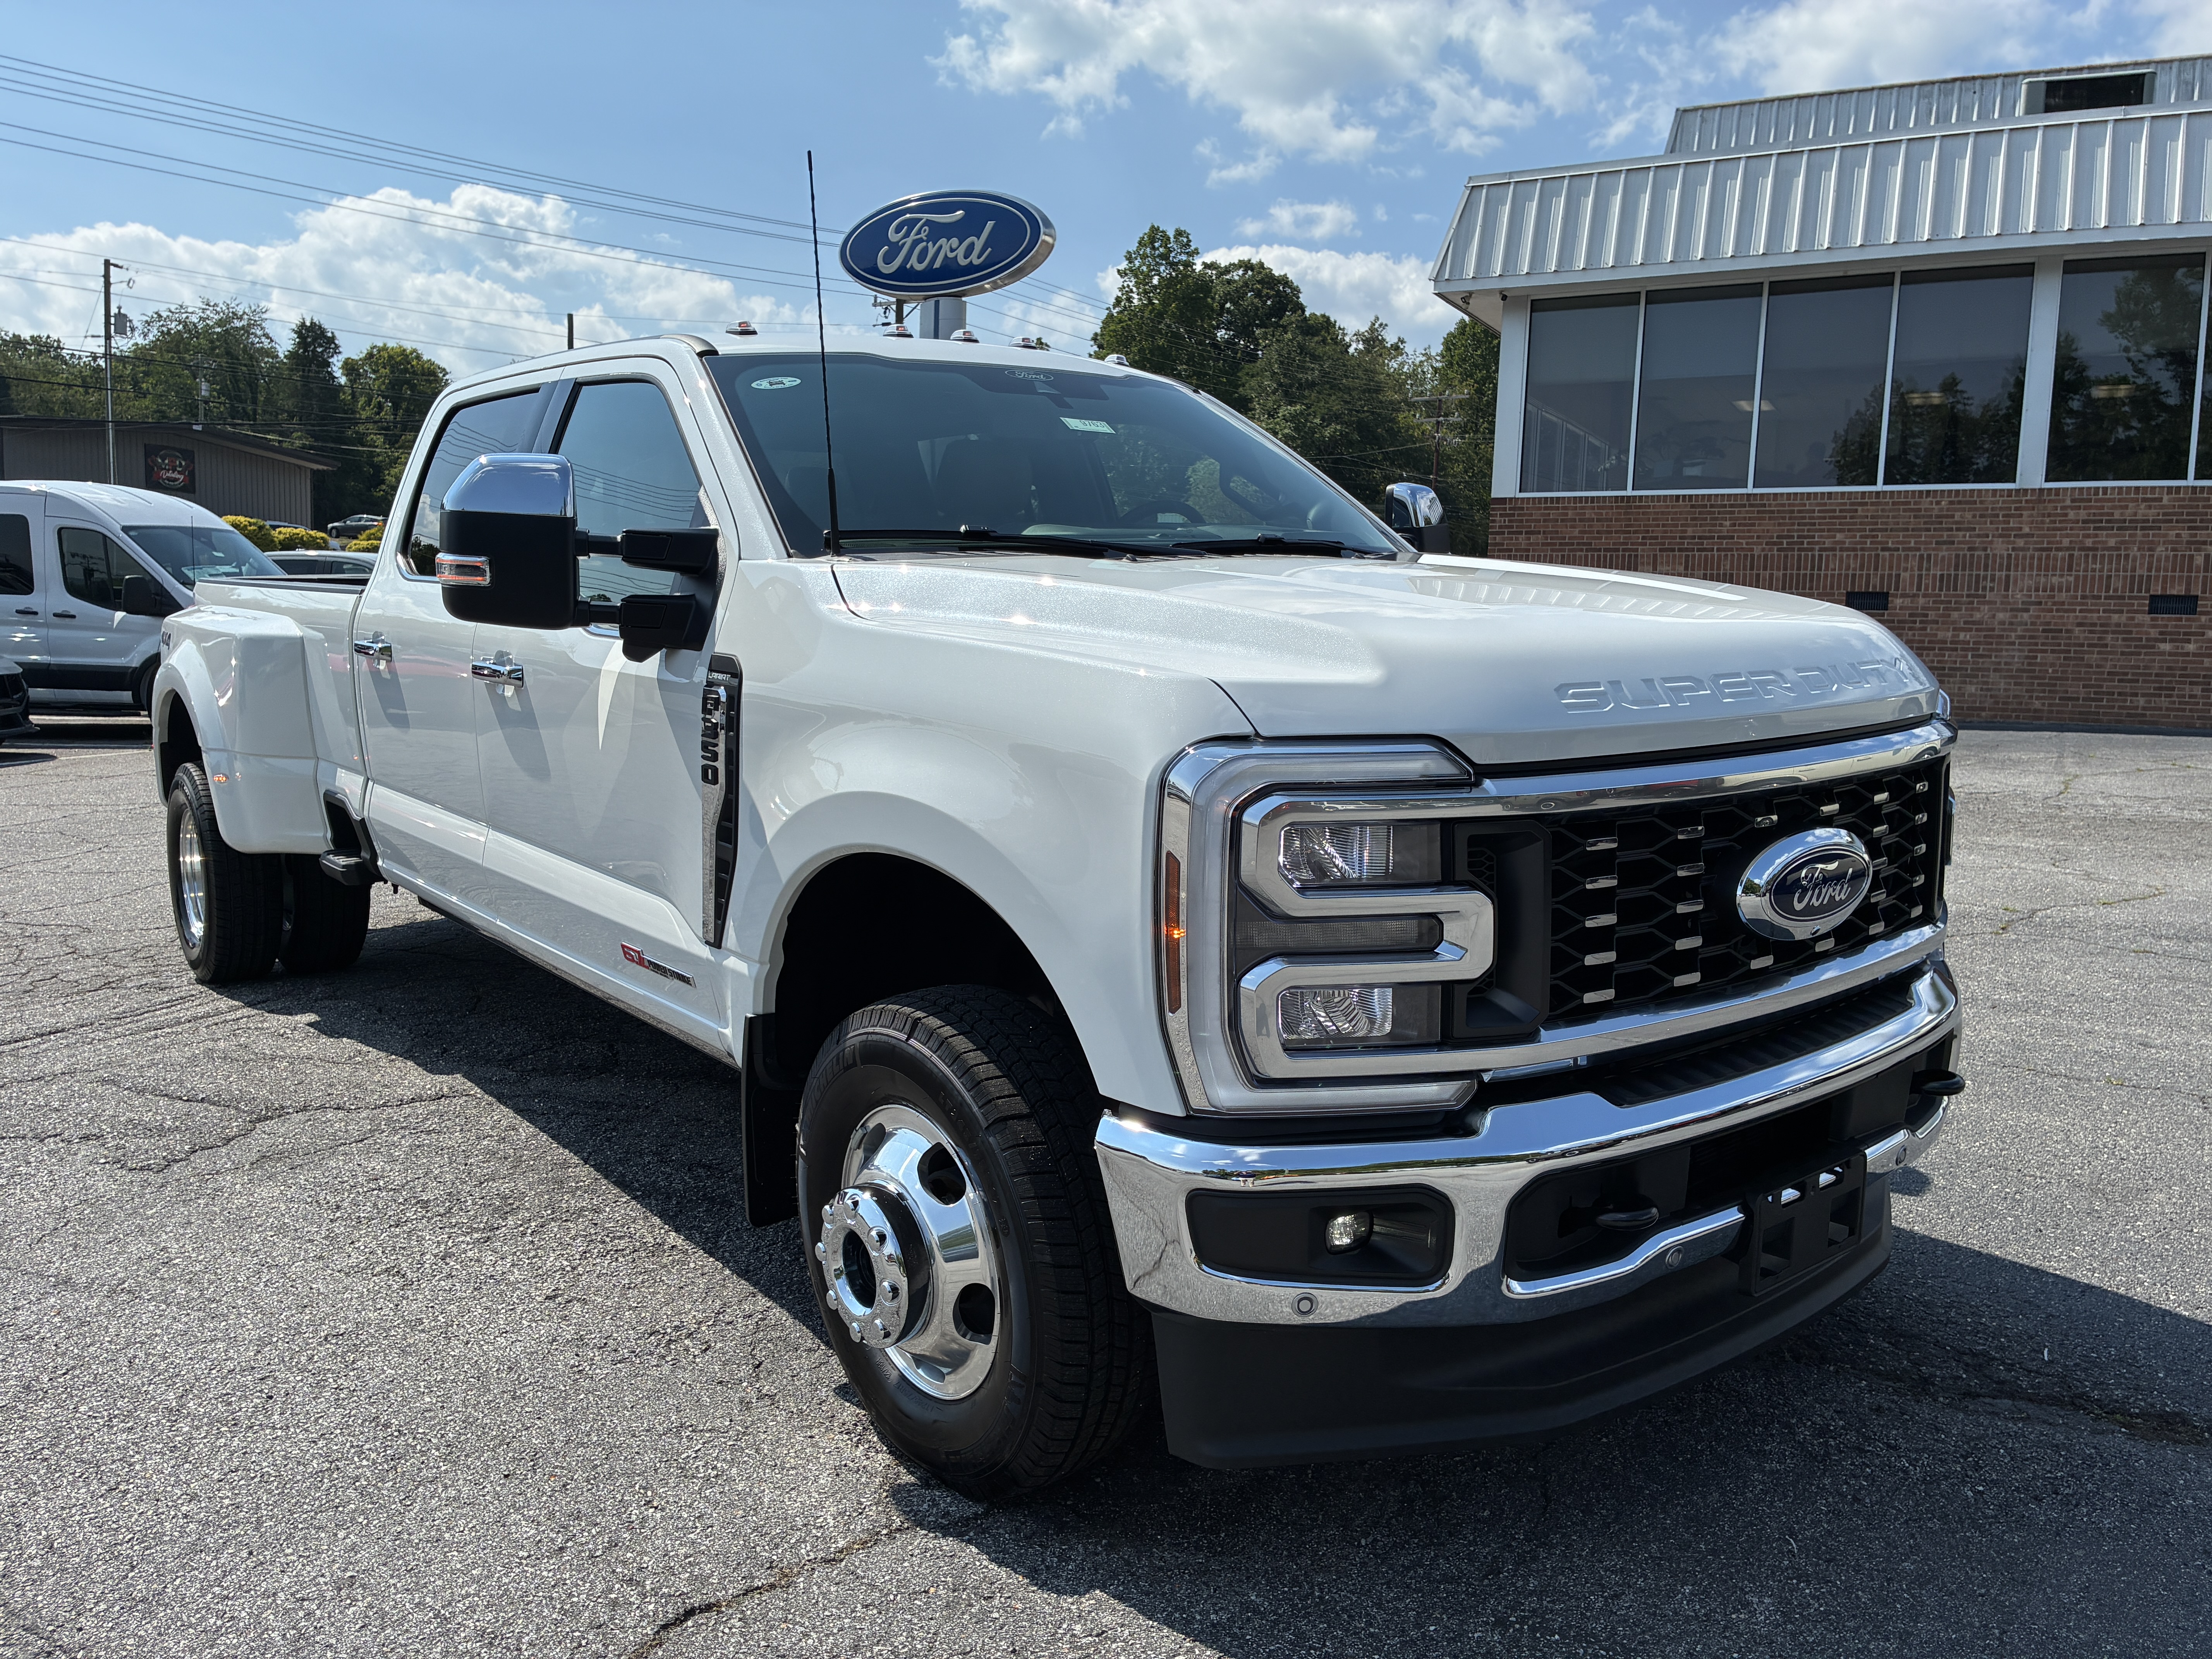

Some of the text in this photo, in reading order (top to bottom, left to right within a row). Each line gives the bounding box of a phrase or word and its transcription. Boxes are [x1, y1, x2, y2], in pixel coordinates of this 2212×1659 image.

[877, 210, 996, 274] Ford
[1015, 370, 1046, 380] Ford
[1079, 420, 1105, 428] 9763
[1554, 658, 1910, 714] SUPER DUTY
[1793, 861, 1853, 911] Ford
